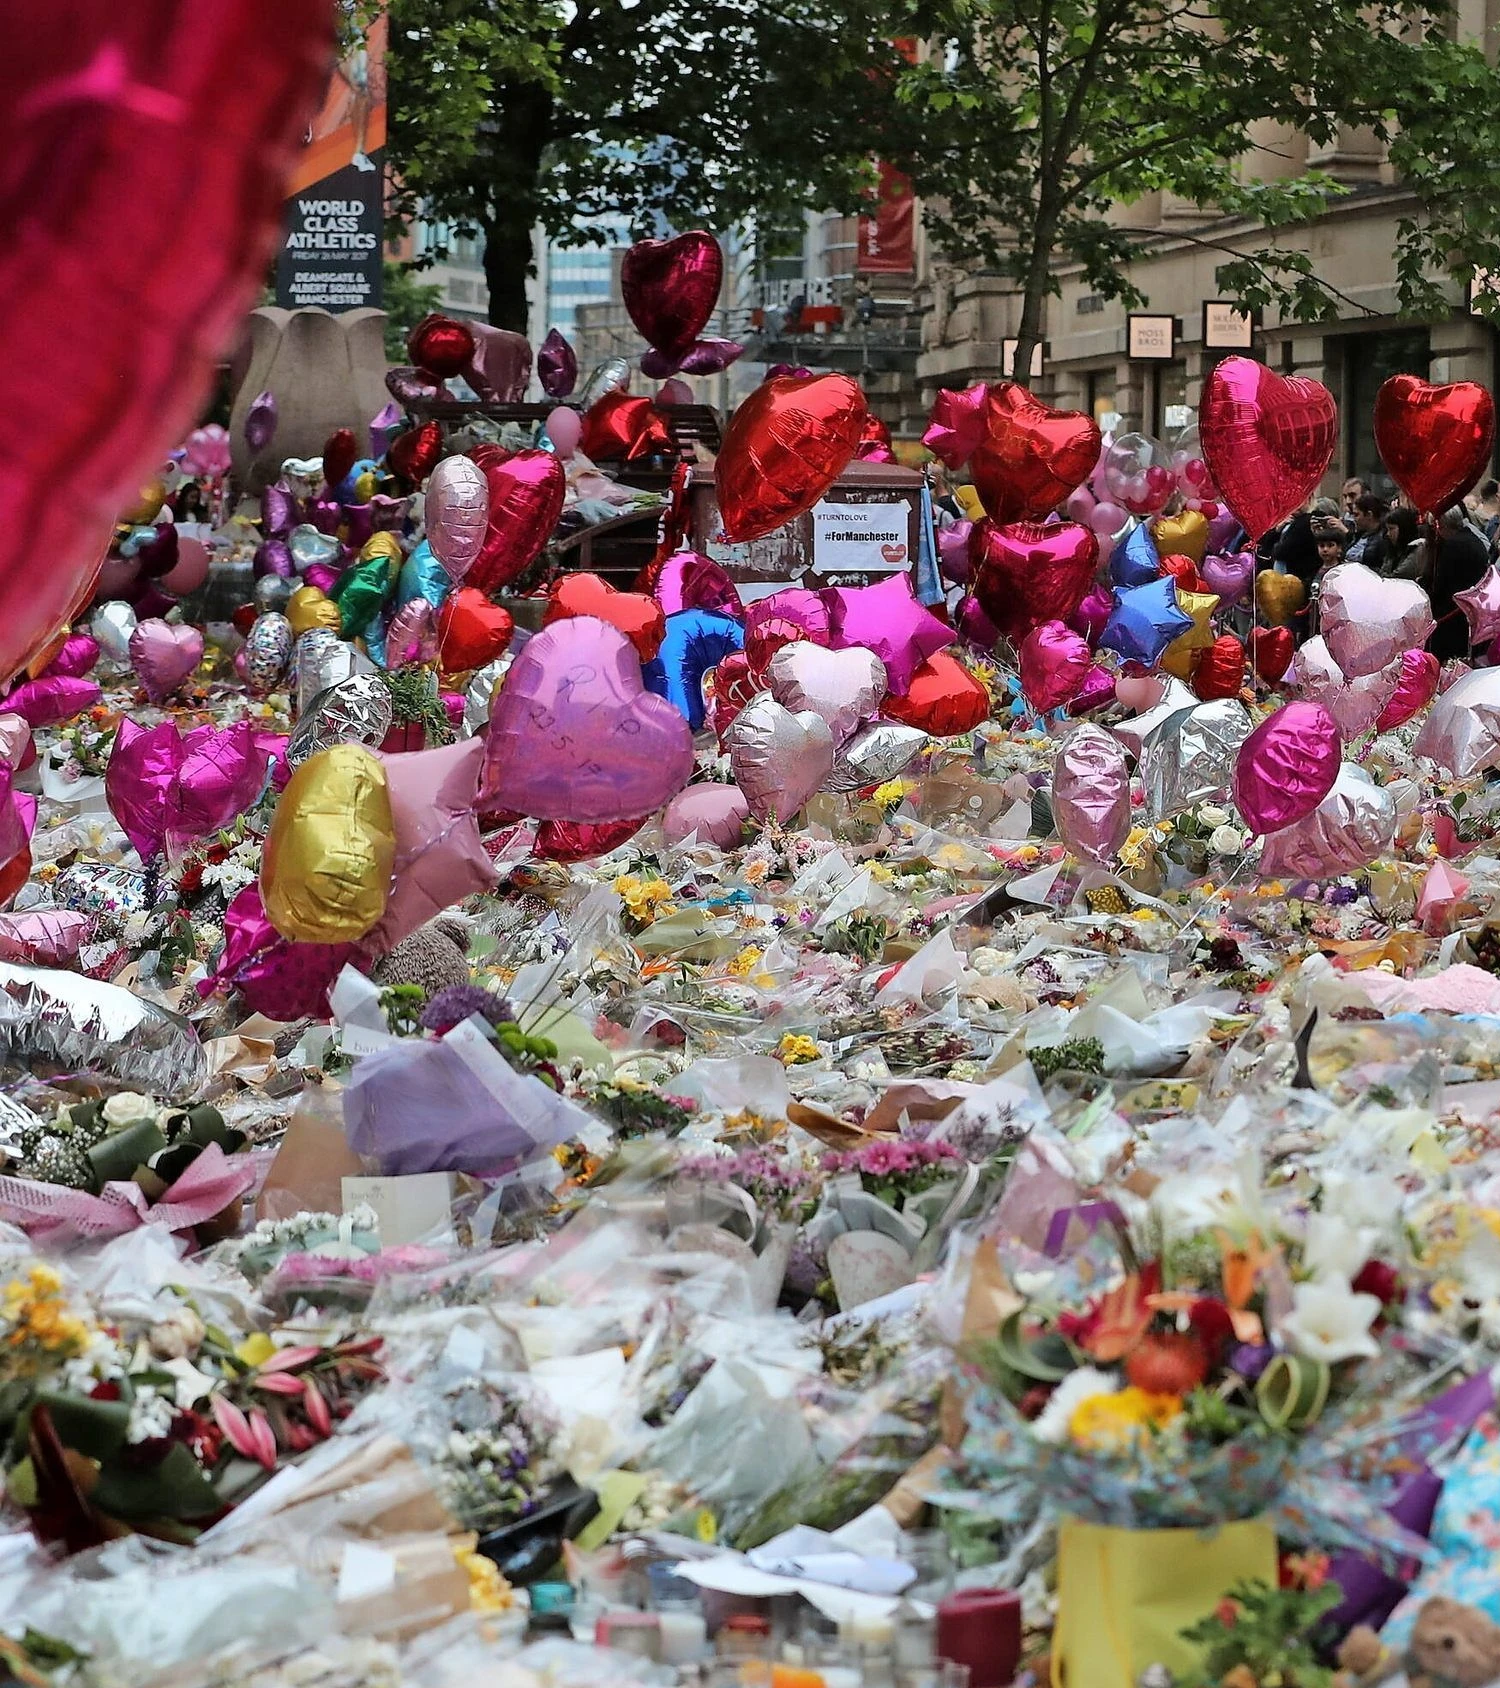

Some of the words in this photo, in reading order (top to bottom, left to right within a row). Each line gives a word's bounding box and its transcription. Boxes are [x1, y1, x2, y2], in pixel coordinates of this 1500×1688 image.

[298, 200, 365, 216] WORLD
[303, 217, 359, 232] CLASS
[286, 232, 377, 249] ATHLETICS
[294, 272, 355, 283] DEANSGATE
[294, 294, 364, 305] MANCHESTER
[1137, 328, 1164, 337] MOSS
[824, 532, 899, 541] #ForManchester
